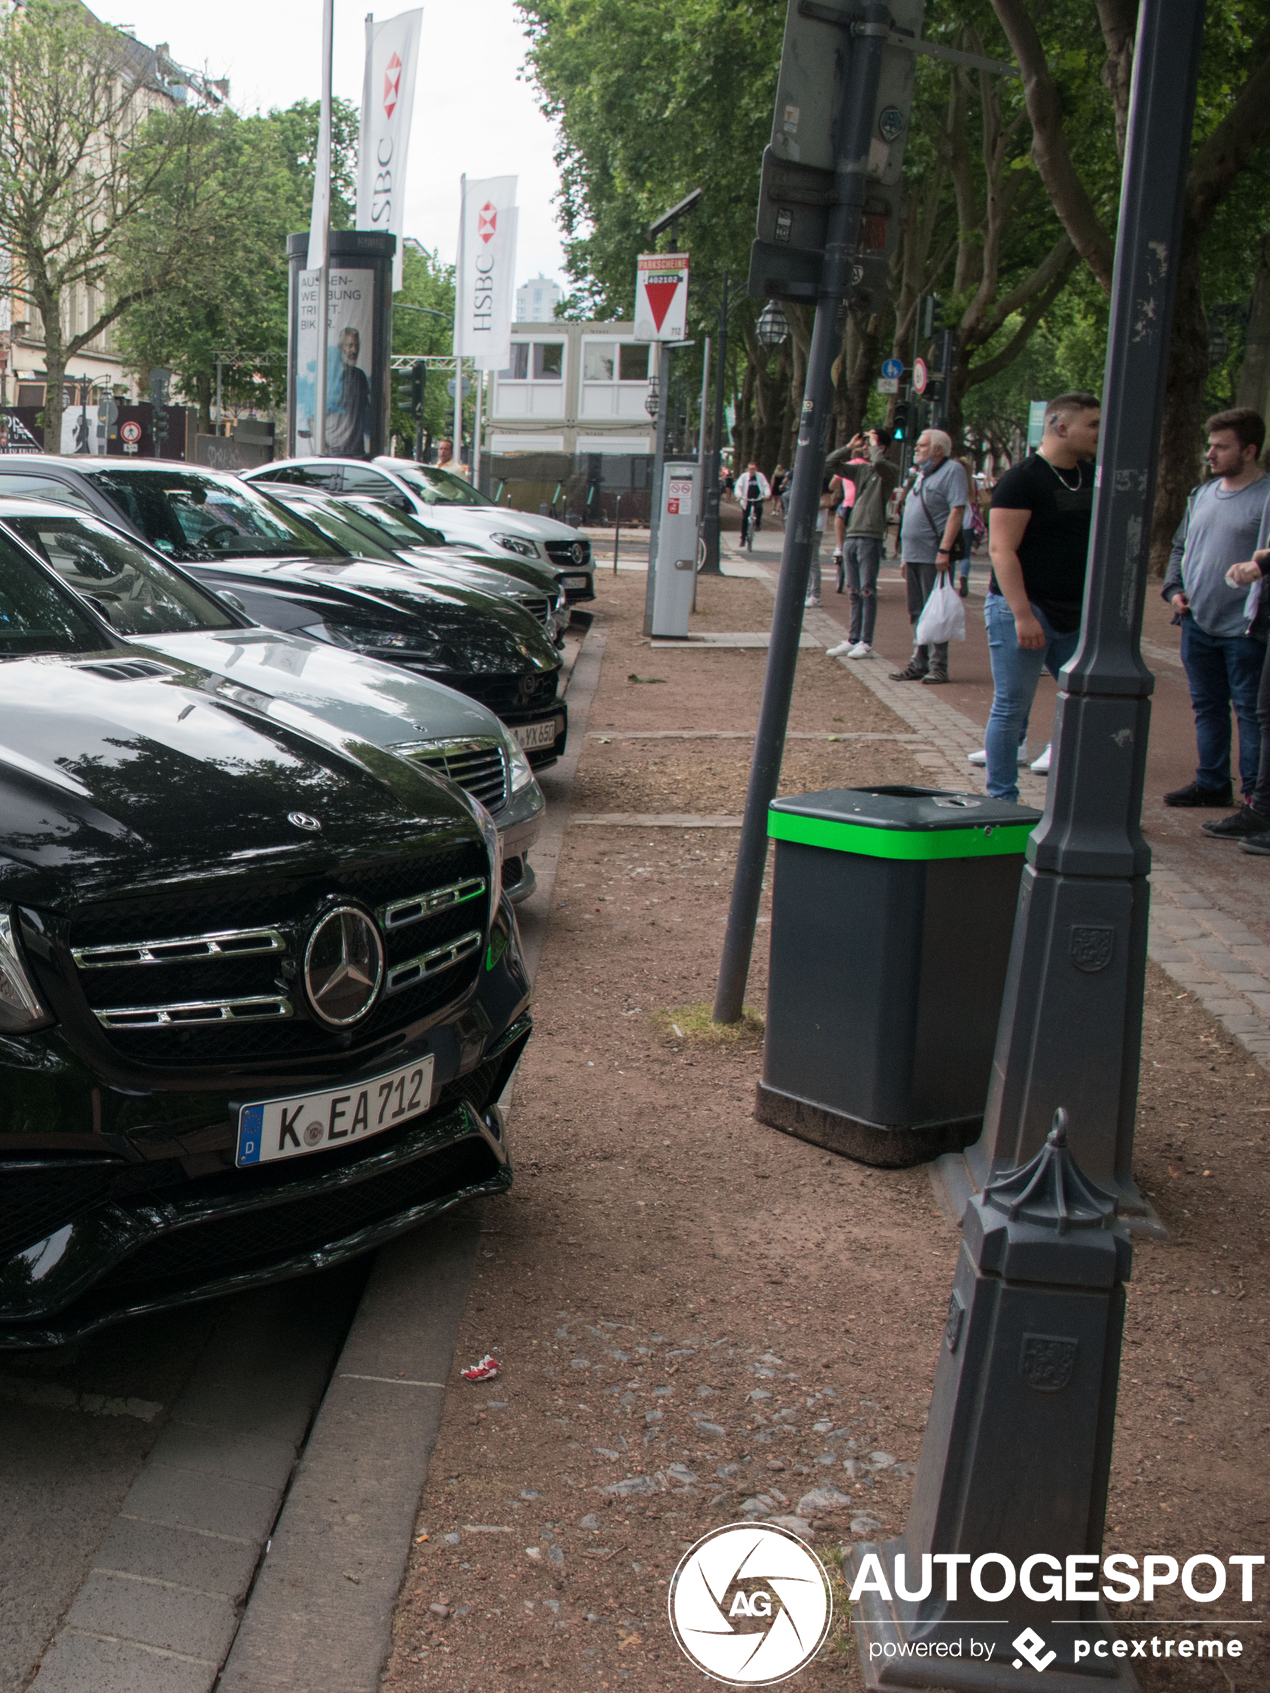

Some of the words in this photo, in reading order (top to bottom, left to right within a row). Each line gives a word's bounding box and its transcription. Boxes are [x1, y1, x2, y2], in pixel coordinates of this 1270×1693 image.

[371, 136, 394, 234] SBC
[639, 259, 687, 269] PARKSCHEINE
[301, 275, 353, 288] AUSEN-
[301, 289, 362, 301] WEBUNG
[473, 254, 495, 332] HSBC
[300, 319, 336, 330] BIKR.
[279, 1104, 305, 1150] K
[245, 1141, 254, 1155] D
